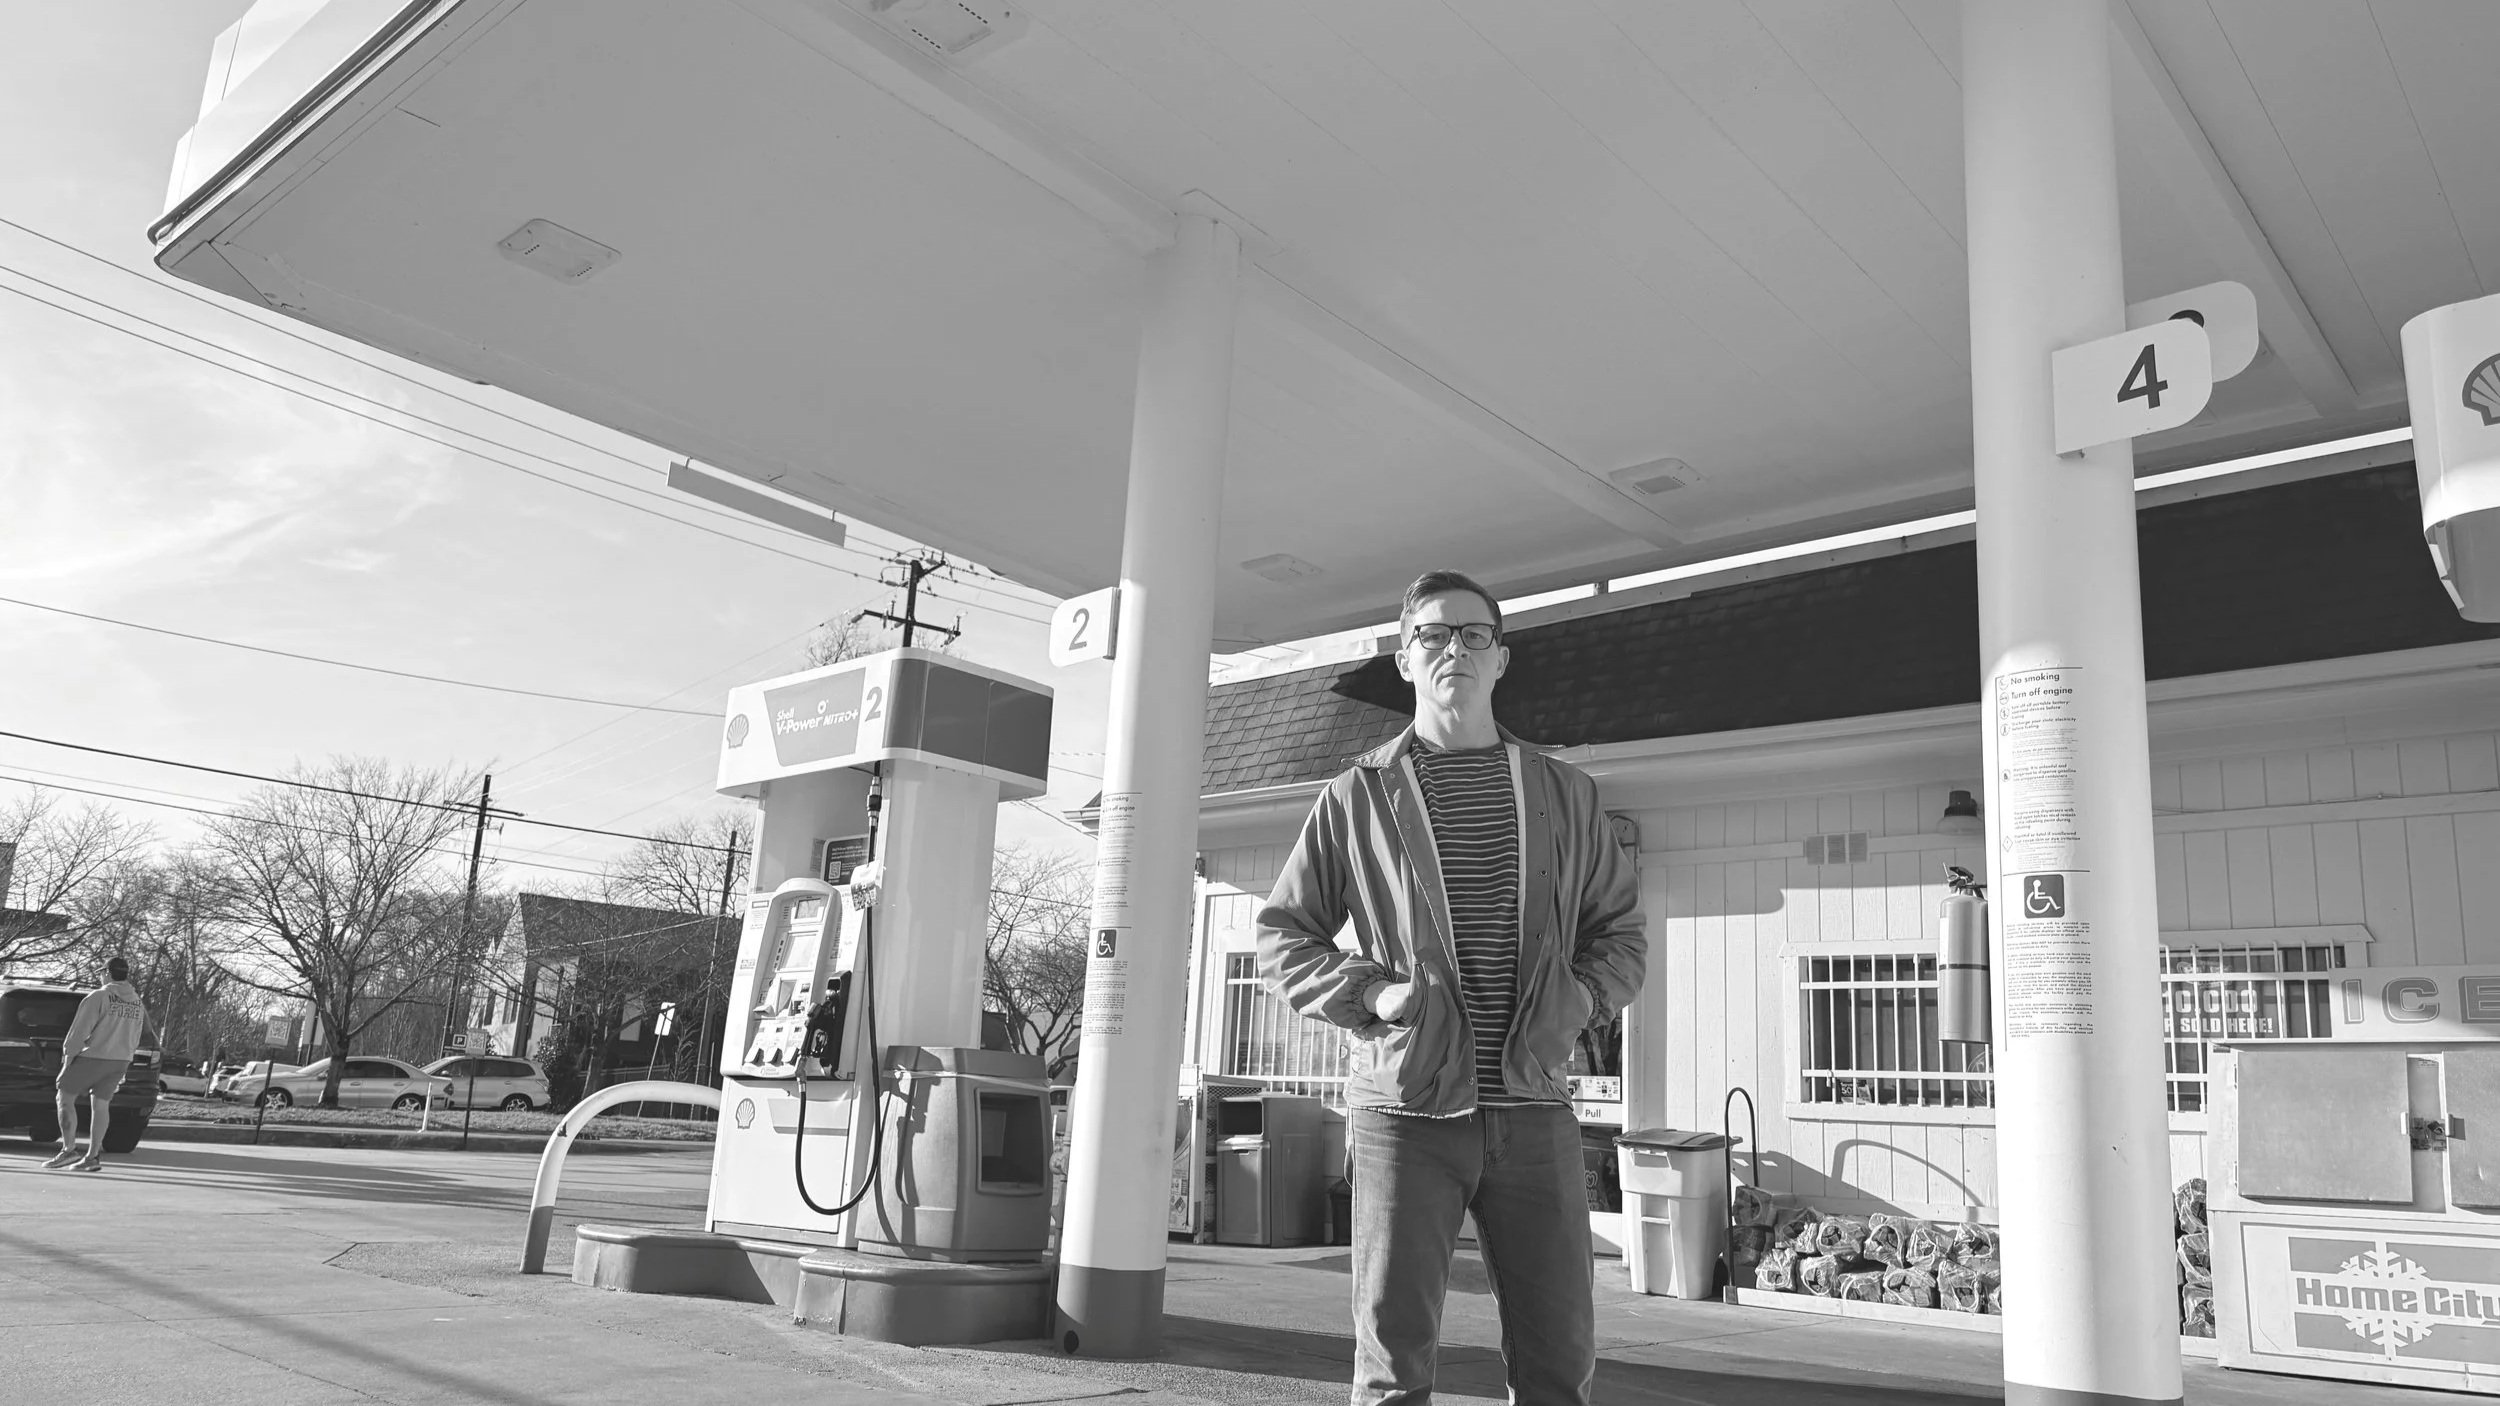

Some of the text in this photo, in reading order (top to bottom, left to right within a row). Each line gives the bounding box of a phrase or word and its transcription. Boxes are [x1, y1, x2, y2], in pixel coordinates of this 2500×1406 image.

[2116, 343, 2169, 410] 4
[1068, 607, 1090, 651] 2
[2011, 673, 2060, 686] No smoking
[2029, 687, 2041, 697] off
[2043, 687, 2073, 697] engine
[777, 706, 795, 722] Shell
[864, 686, 883, 722] 2
[776, 708, 859, 736] V-Power NITRO+
[2341, 975, 2500, 1024] ICE
[109, 1003, 140, 1019] FIRE
[2180, 1017, 2221, 1033] SOLD
[2227, 1017, 2274, 1033] HERE!
[1585, 1109, 1601, 1118] Pull
[2296, 1277, 2418, 1314] Home
